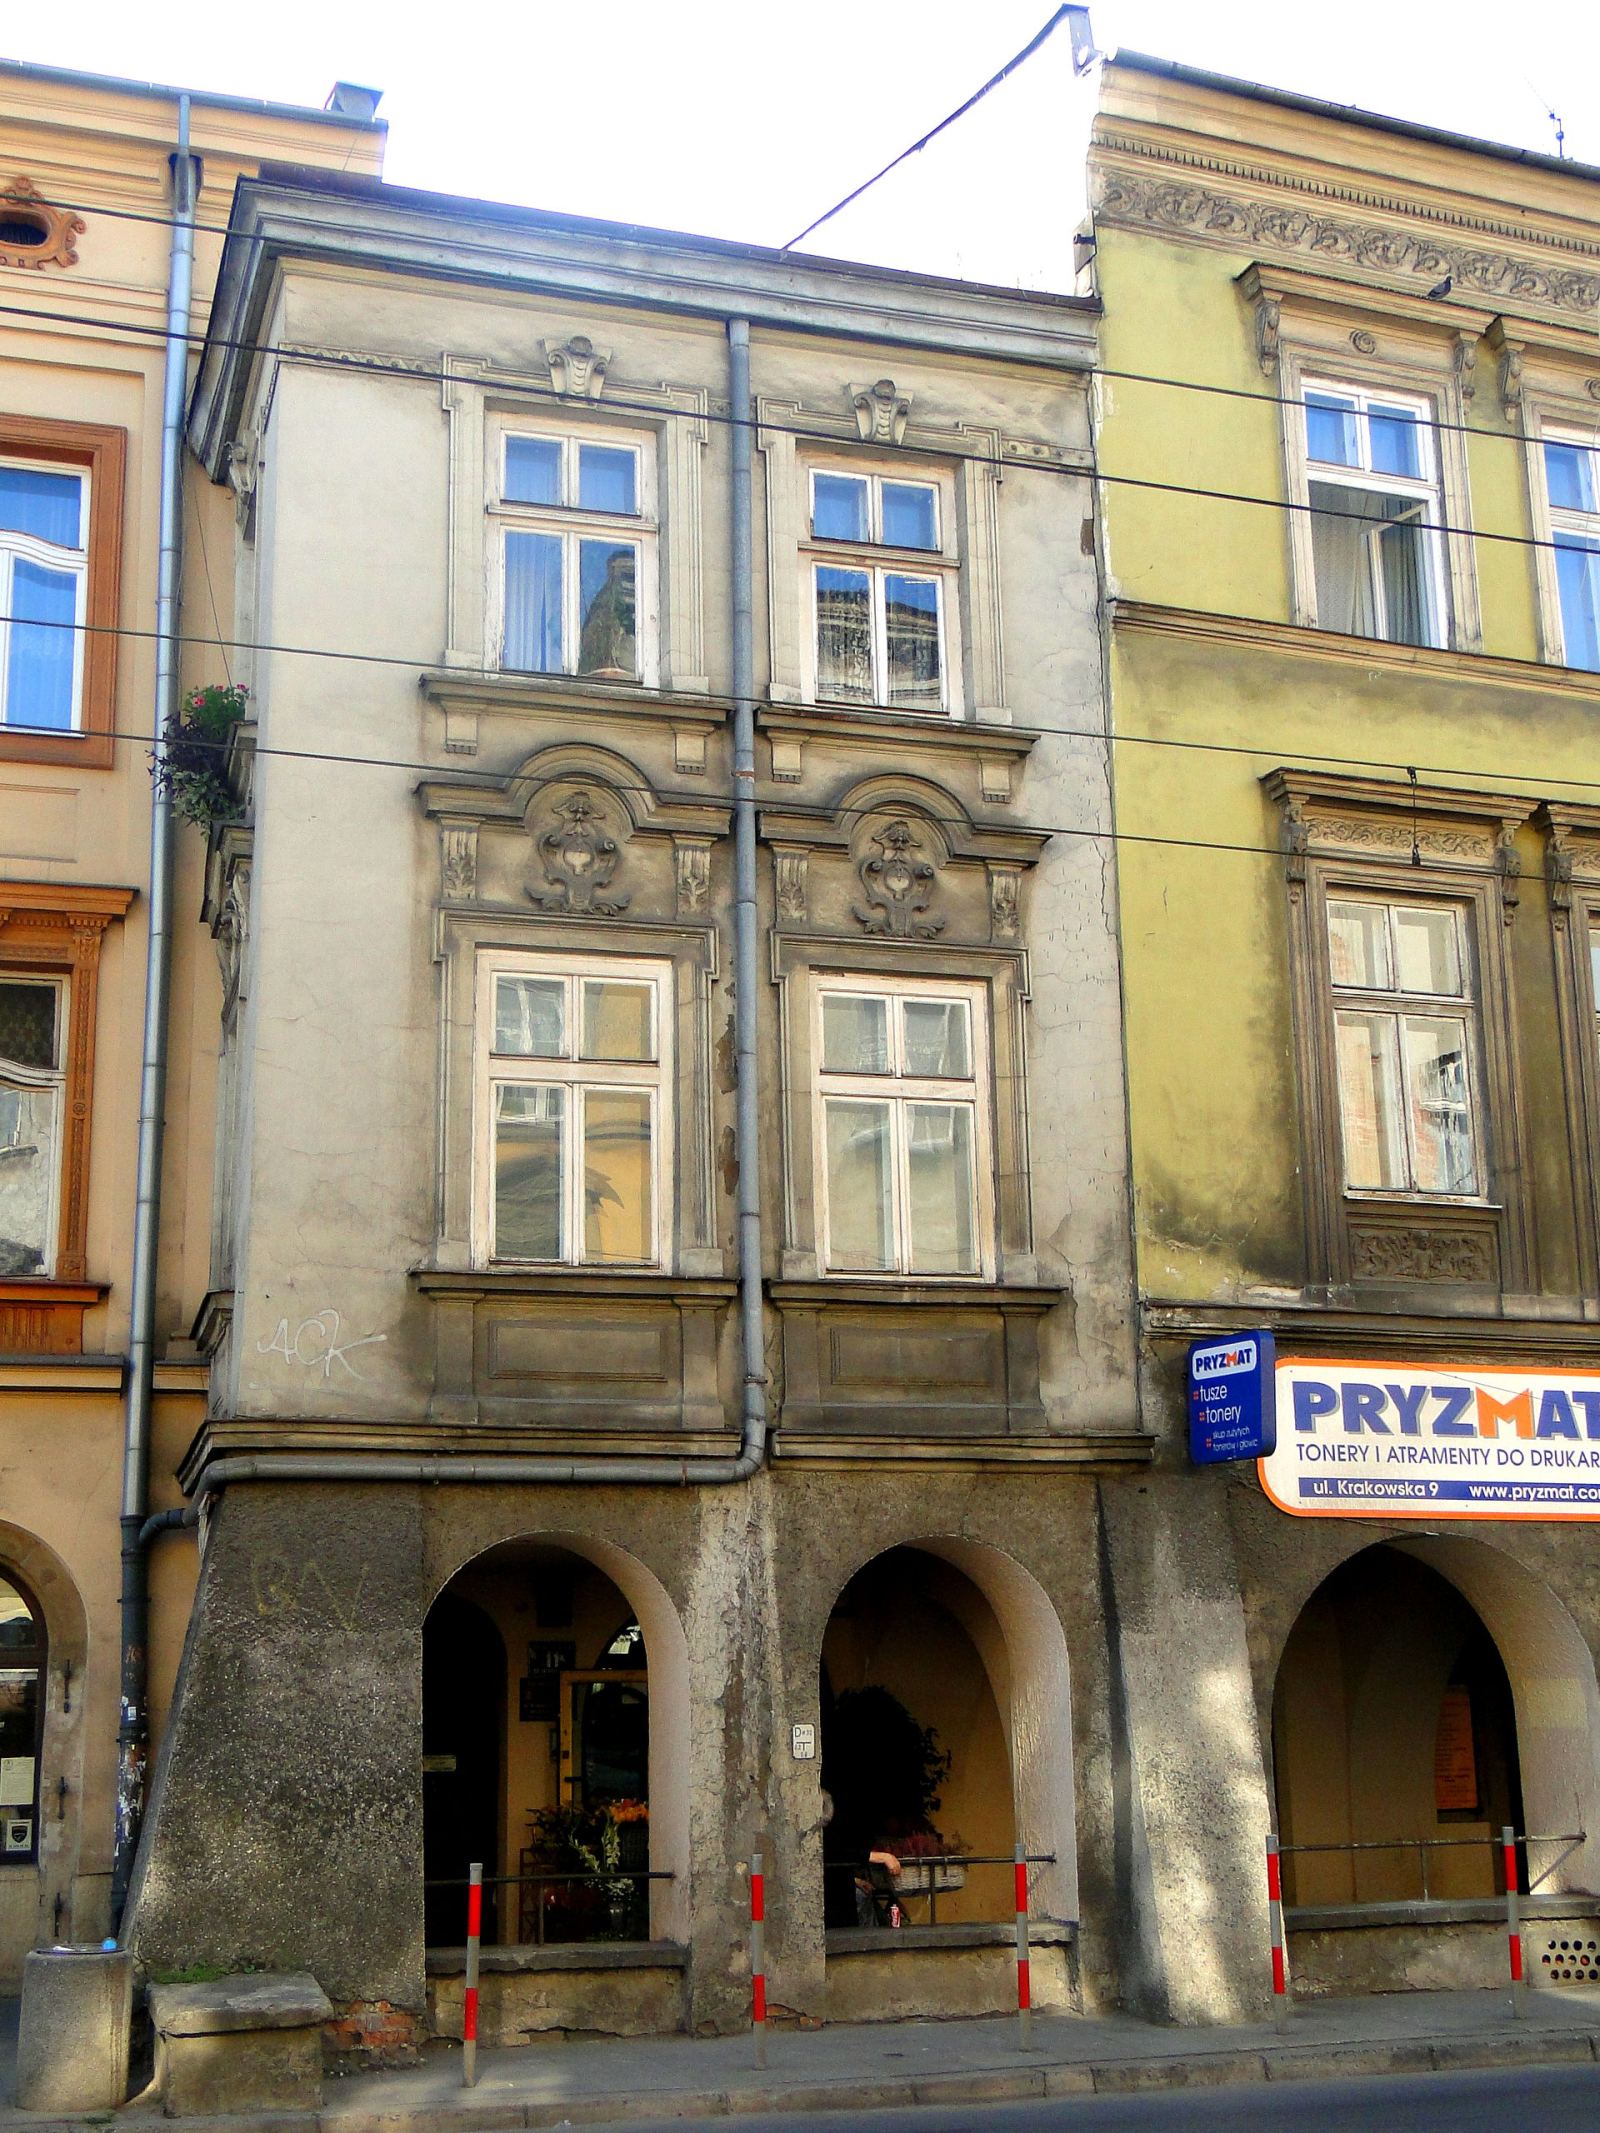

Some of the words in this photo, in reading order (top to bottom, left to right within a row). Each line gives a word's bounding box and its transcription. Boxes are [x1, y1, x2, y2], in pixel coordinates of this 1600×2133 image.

[1196, 1348, 1252, 1373] PRYZMAT
[1200, 1385, 1228, 1402] tusze
[1206, 1405, 1241, 1424] tonery
[1292, 1381, 1600, 1441] PRYZMAT
[1296, 1444, 1369, 1462] TONERY
[1376, 1446, 1380, 1462] I
[1387, 1446, 1490, 1465] ATRAMENTY
[1497, 1449, 1524, 1466] DO
[1313, 1480, 1332, 1495] ul.
[1338, 1480, 1425, 1497] Krakowska
[1429, 1482, 1439, 1497] 9
[1469, 1485, 1600, 1501] www.pryzmat.co
